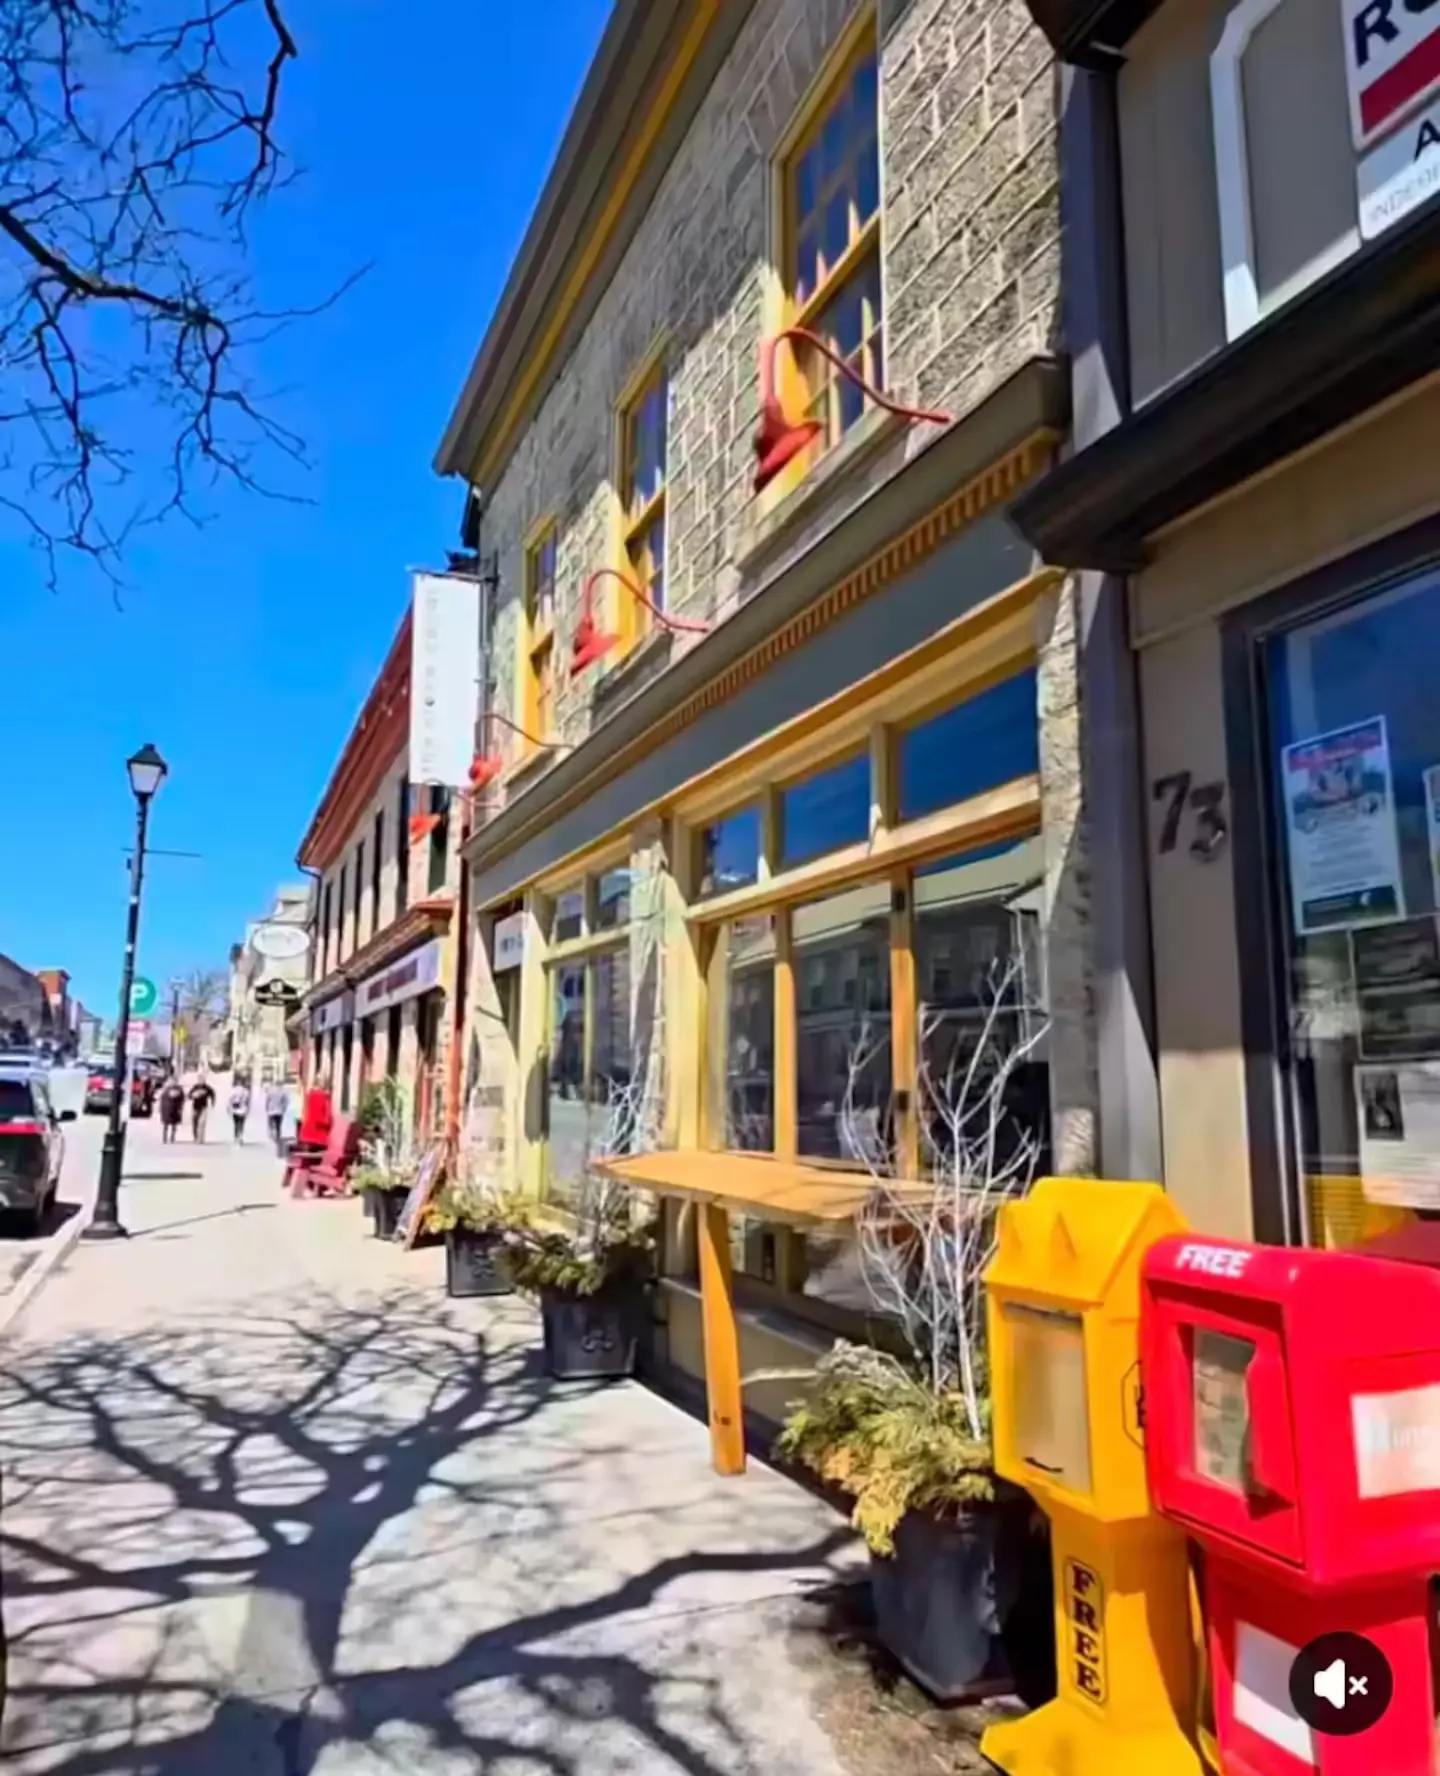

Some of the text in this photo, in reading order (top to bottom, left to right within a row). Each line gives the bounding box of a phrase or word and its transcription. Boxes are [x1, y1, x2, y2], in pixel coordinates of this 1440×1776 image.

[1153, 770, 1226, 864] 73
[130, 984, 148, 1011] P
[1177, 1244, 1251, 1277] FREE
[1072, 1564, 1101, 1698] FREE
